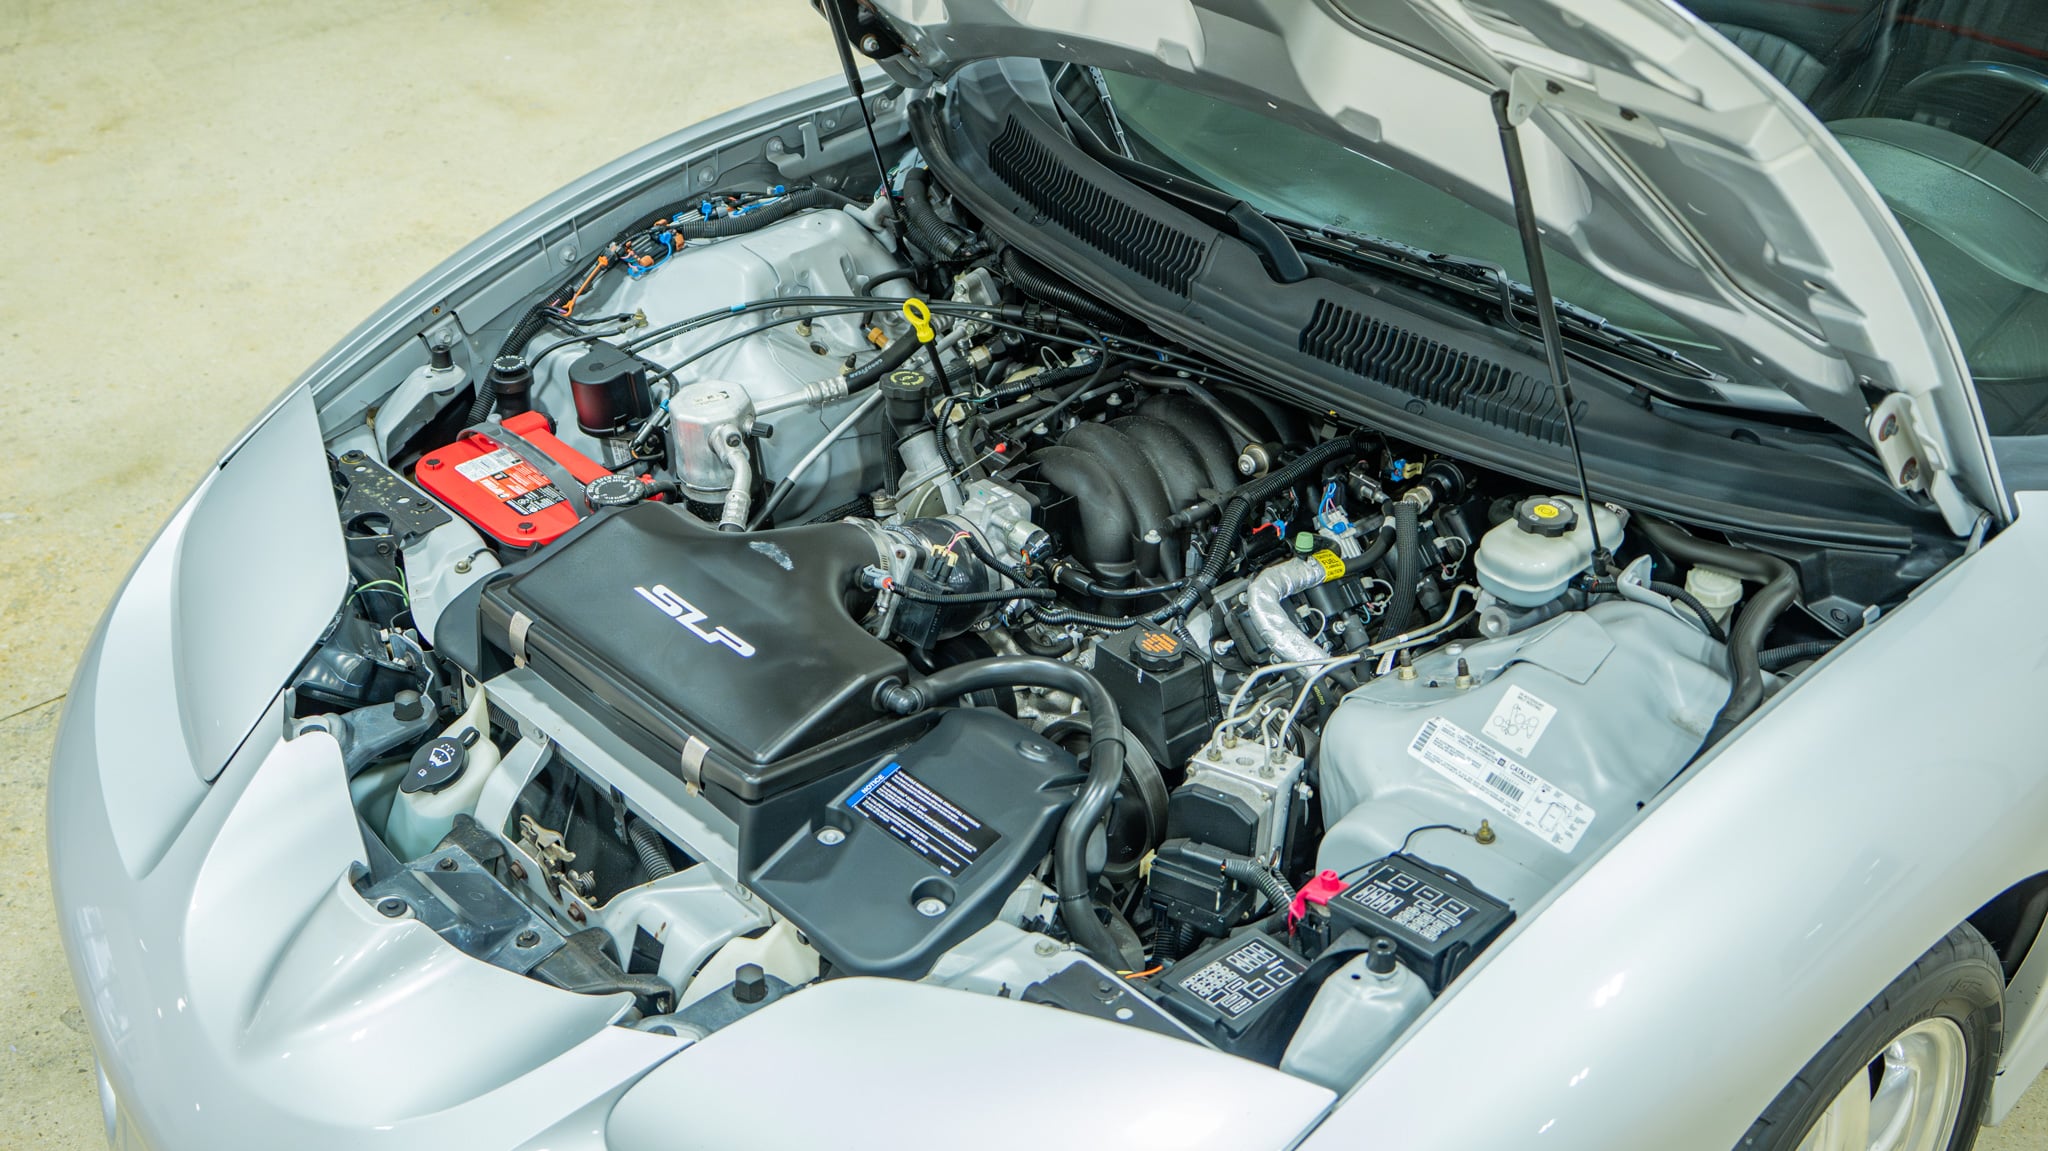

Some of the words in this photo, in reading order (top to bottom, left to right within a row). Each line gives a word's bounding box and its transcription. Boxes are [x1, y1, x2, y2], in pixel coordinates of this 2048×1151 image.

[633, 584, 756, 658] SLP
[1509, 763, 1538, 783] CATALYST
[861, 774, 884, 794] NOTICE
